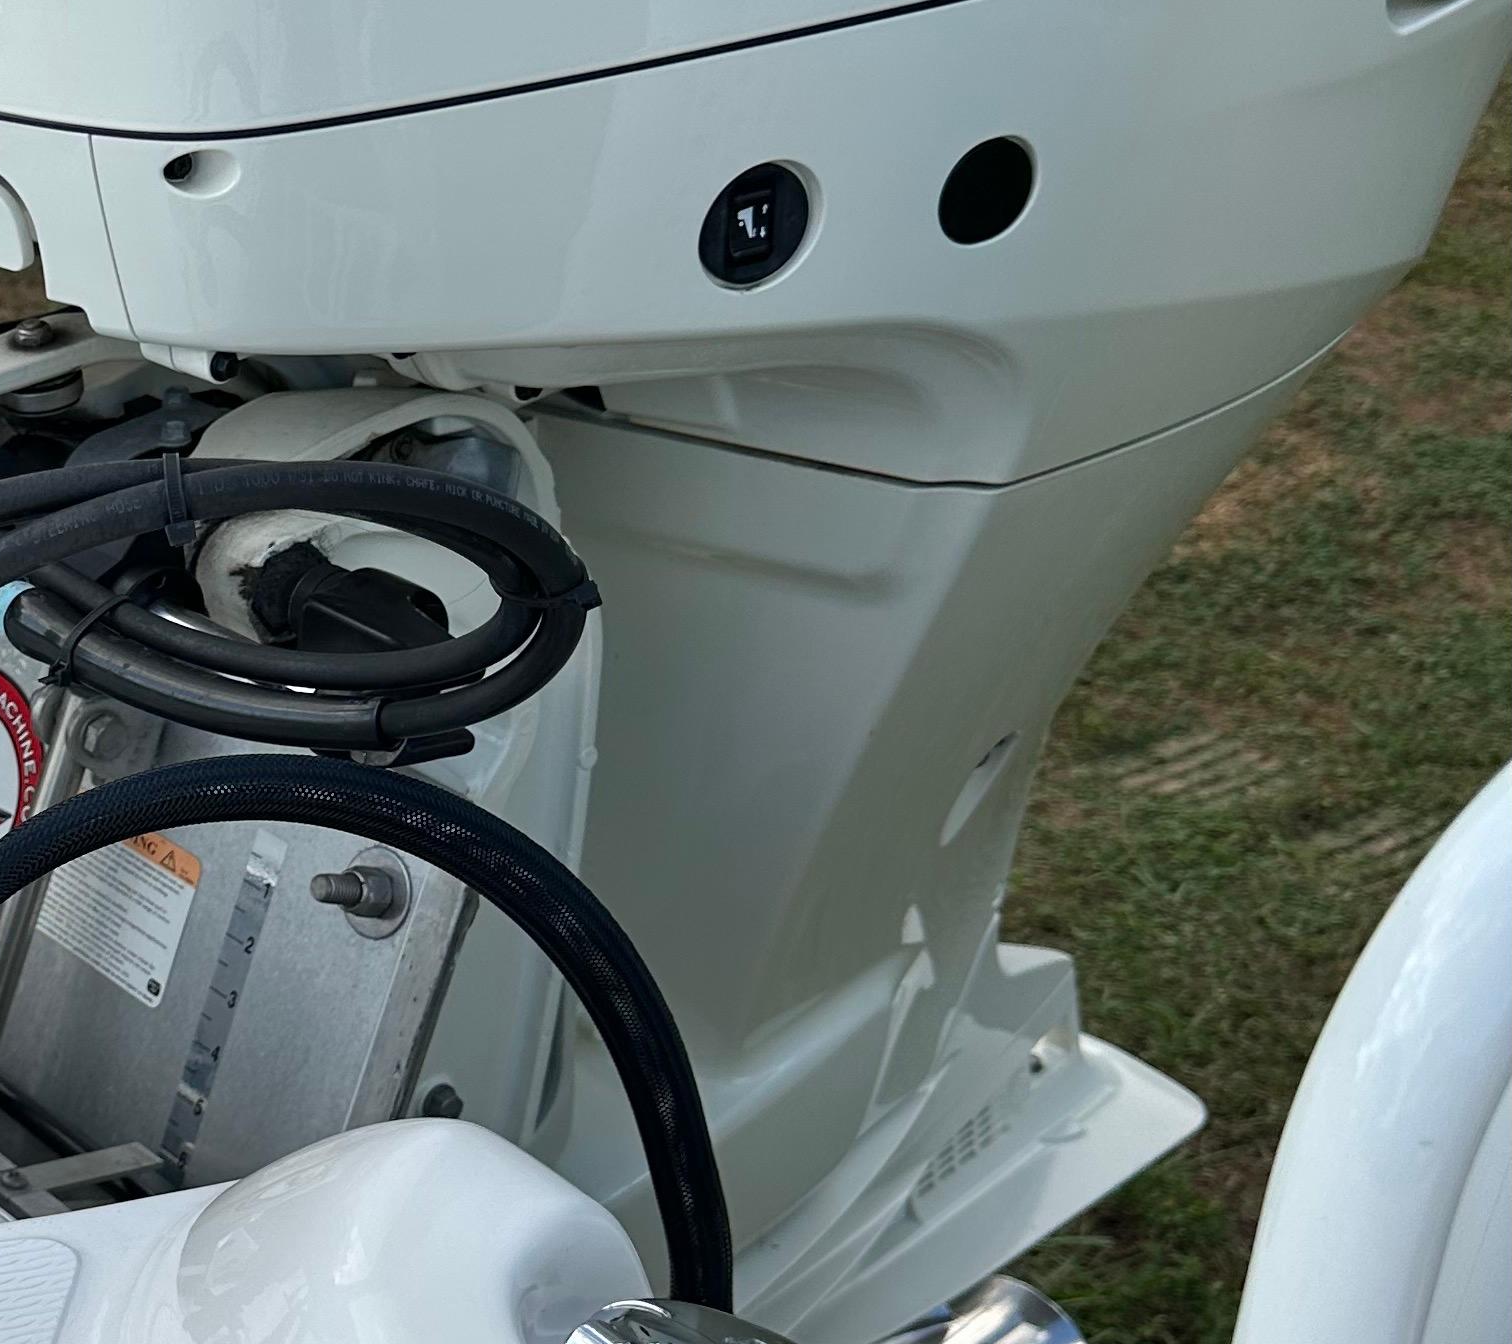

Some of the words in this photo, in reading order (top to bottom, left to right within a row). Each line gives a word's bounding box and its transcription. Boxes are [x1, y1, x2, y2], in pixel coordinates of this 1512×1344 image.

[243, 935, 256, 955] 2
[226, 989, 240, 1009] 3
[209, 1044, 222, 1063] 4
